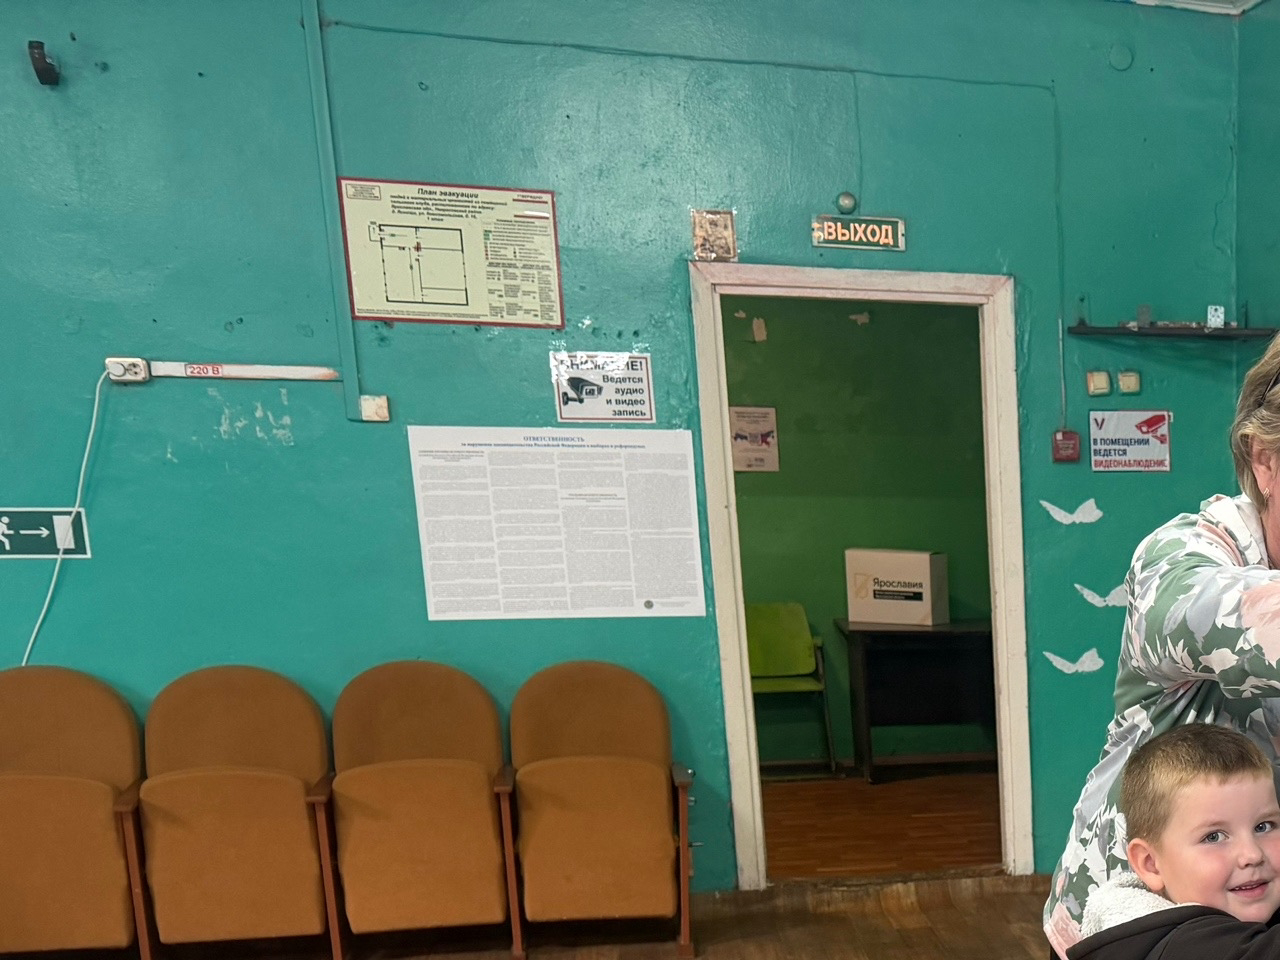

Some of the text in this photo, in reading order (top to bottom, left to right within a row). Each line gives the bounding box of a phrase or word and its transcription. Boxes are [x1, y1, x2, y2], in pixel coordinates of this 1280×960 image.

[418, 188, 479, 199] План эвакуации
[824, 222, 894, 245] ВЫХОД
[190, 366, 220, 376] 220 В
[603, 375, 643, 383] Ведется
[615, 387, 644, 396] аудио
[1100, 438, 1150, 447] ПОМЕЩЕНИИ
[1094, 449, 1127, 457] ВЕДЕТСЯ
[873, 578, 923, 590] Ярославия
